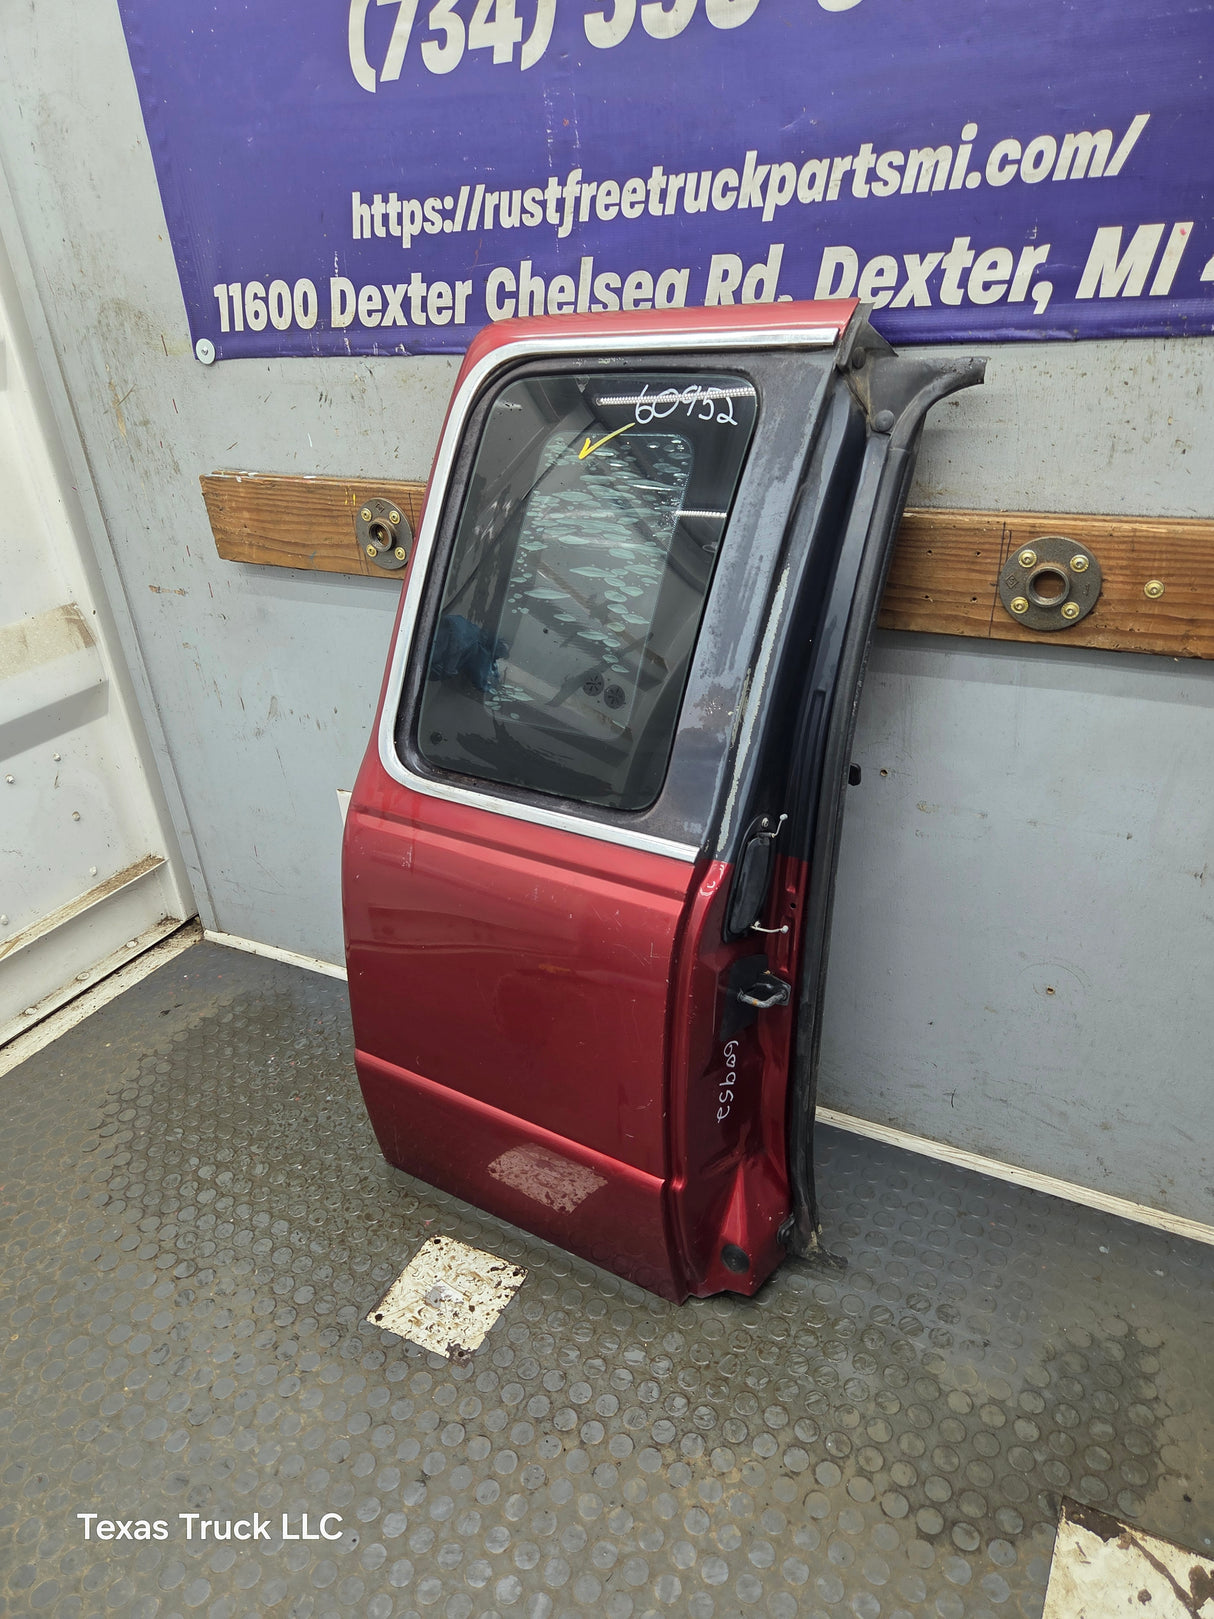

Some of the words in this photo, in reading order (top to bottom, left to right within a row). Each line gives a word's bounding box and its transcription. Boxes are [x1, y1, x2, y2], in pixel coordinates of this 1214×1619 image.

[348, 0, 557, 93] (734)
[352, 113, 1151, 249] https://rustfreetruckpartsmi.com/
[214, 279, 318, 333] 11600
[330, 273, 473, 329] Dexter
[485, 255, 691, 323] Chelsea
[813, 236, 1055, 315] Dexter,
[1075, 221, 1195, 299] MI
[634, 383, 738, 425] 60952
